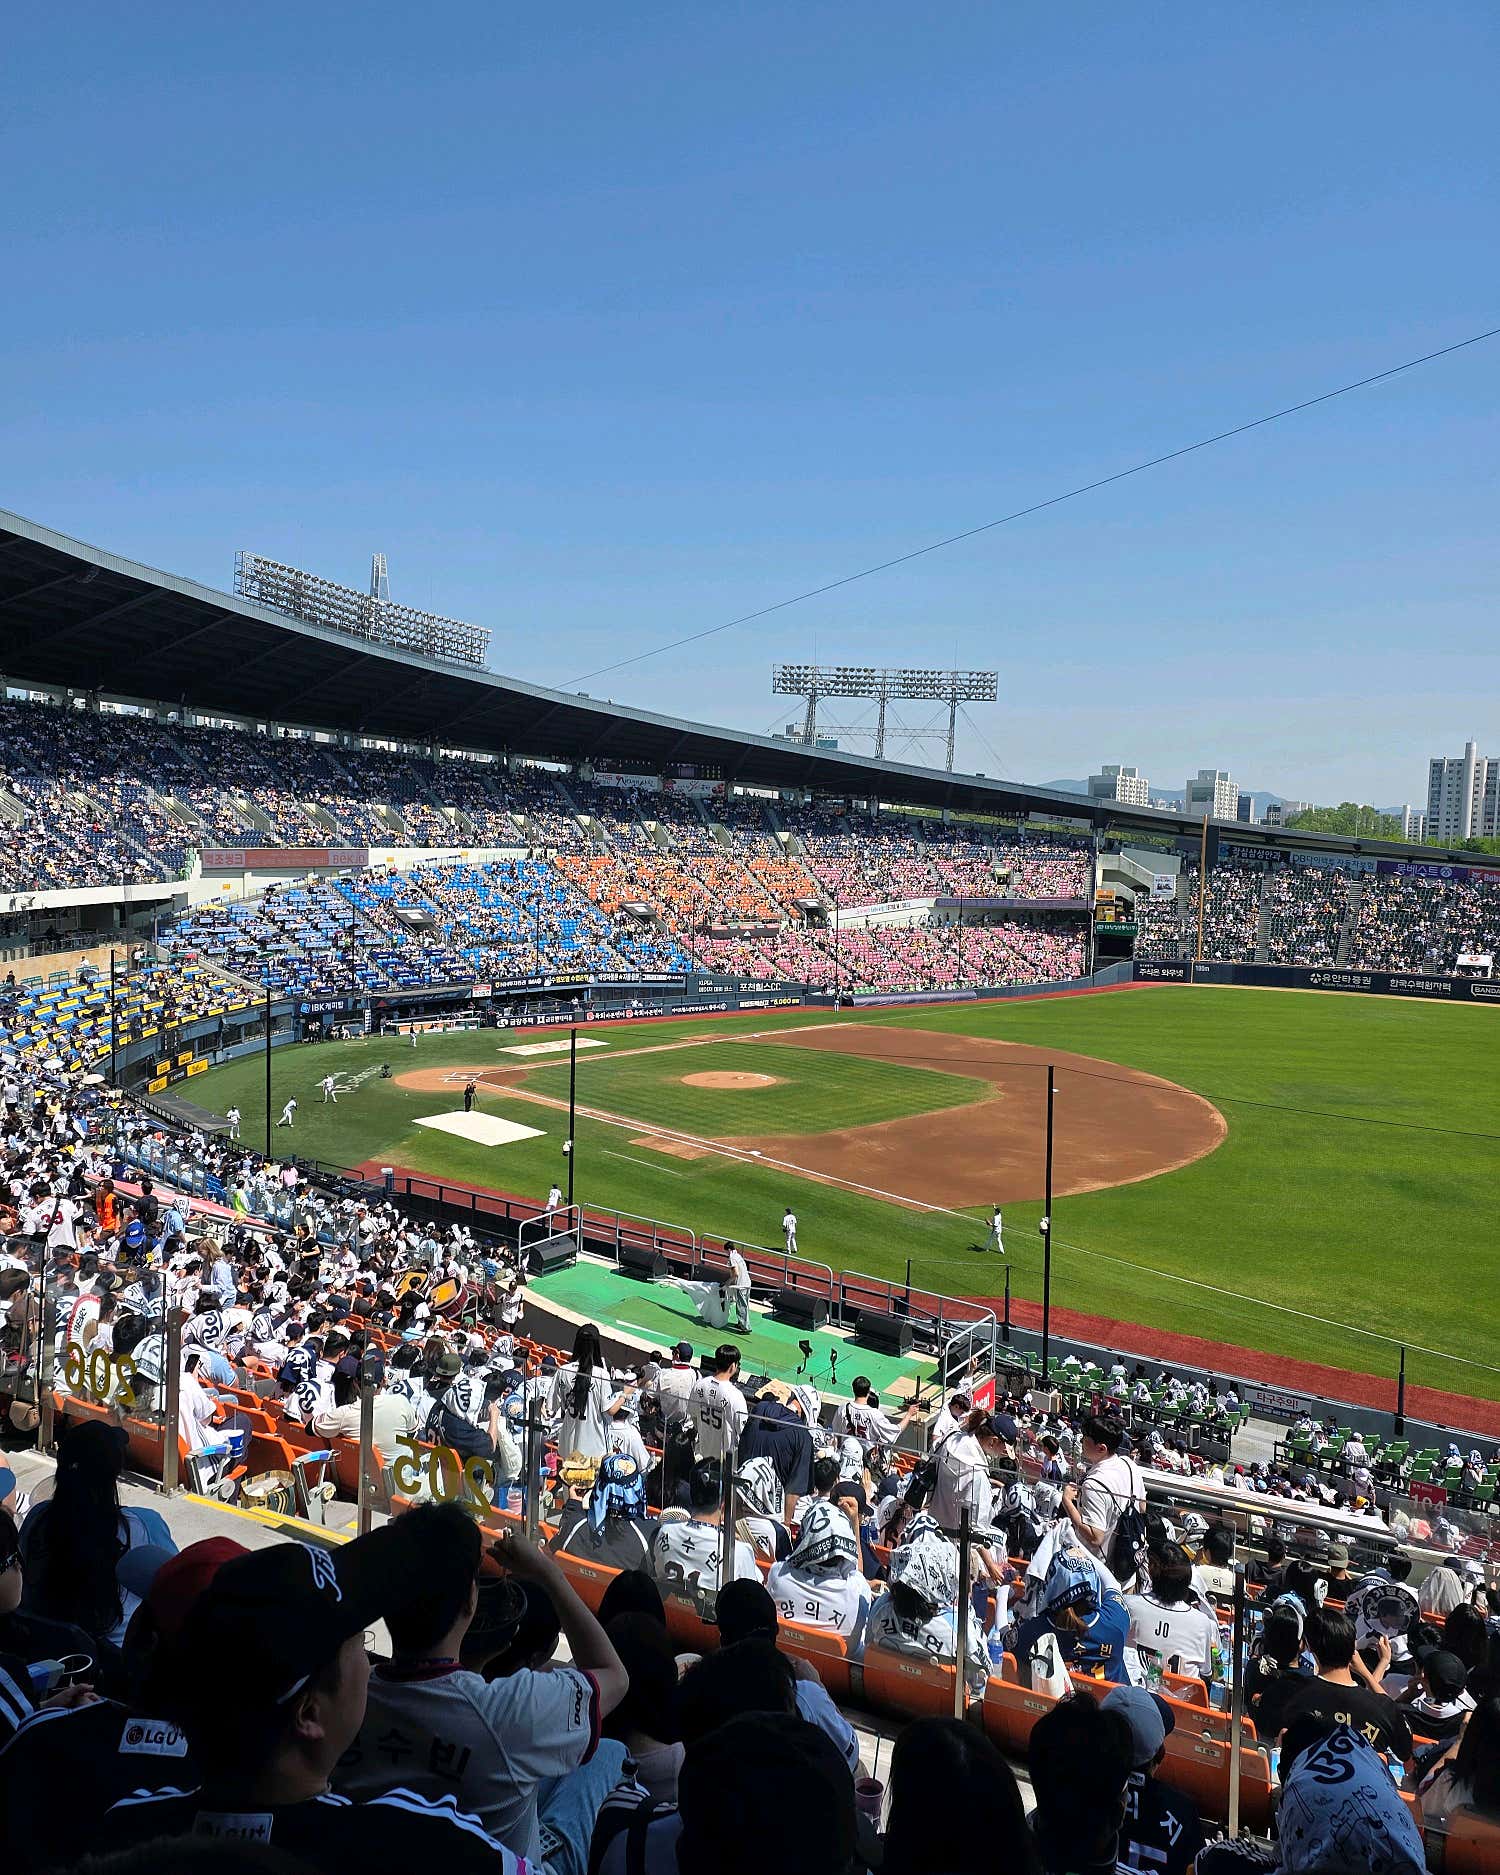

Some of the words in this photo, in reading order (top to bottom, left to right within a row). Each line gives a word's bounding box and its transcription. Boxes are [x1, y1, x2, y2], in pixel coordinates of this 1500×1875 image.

[1397, 863, 1439, 876] 몽베스트
[1161, 968, 1184, 977] 와우넷
[1322, 974, 1372, 985] 유안타증권
[740, 982, 781, 992] 포천힐스CC
[1390, 979, 1451, 991] 한국수력원자력
[1256, 1392, 1299, 1410] 타구주의!
[700, 1407, 722, 1430] 25
[1410, 1494, 1444, 1516] 104
[657, 1531, 724, 1572] 정수빈
[780, 1600, 846, 1630] 양의지
[880, 1616, 944, 1653] 김택연
[1154, 1620, 1170, 1638] JO
